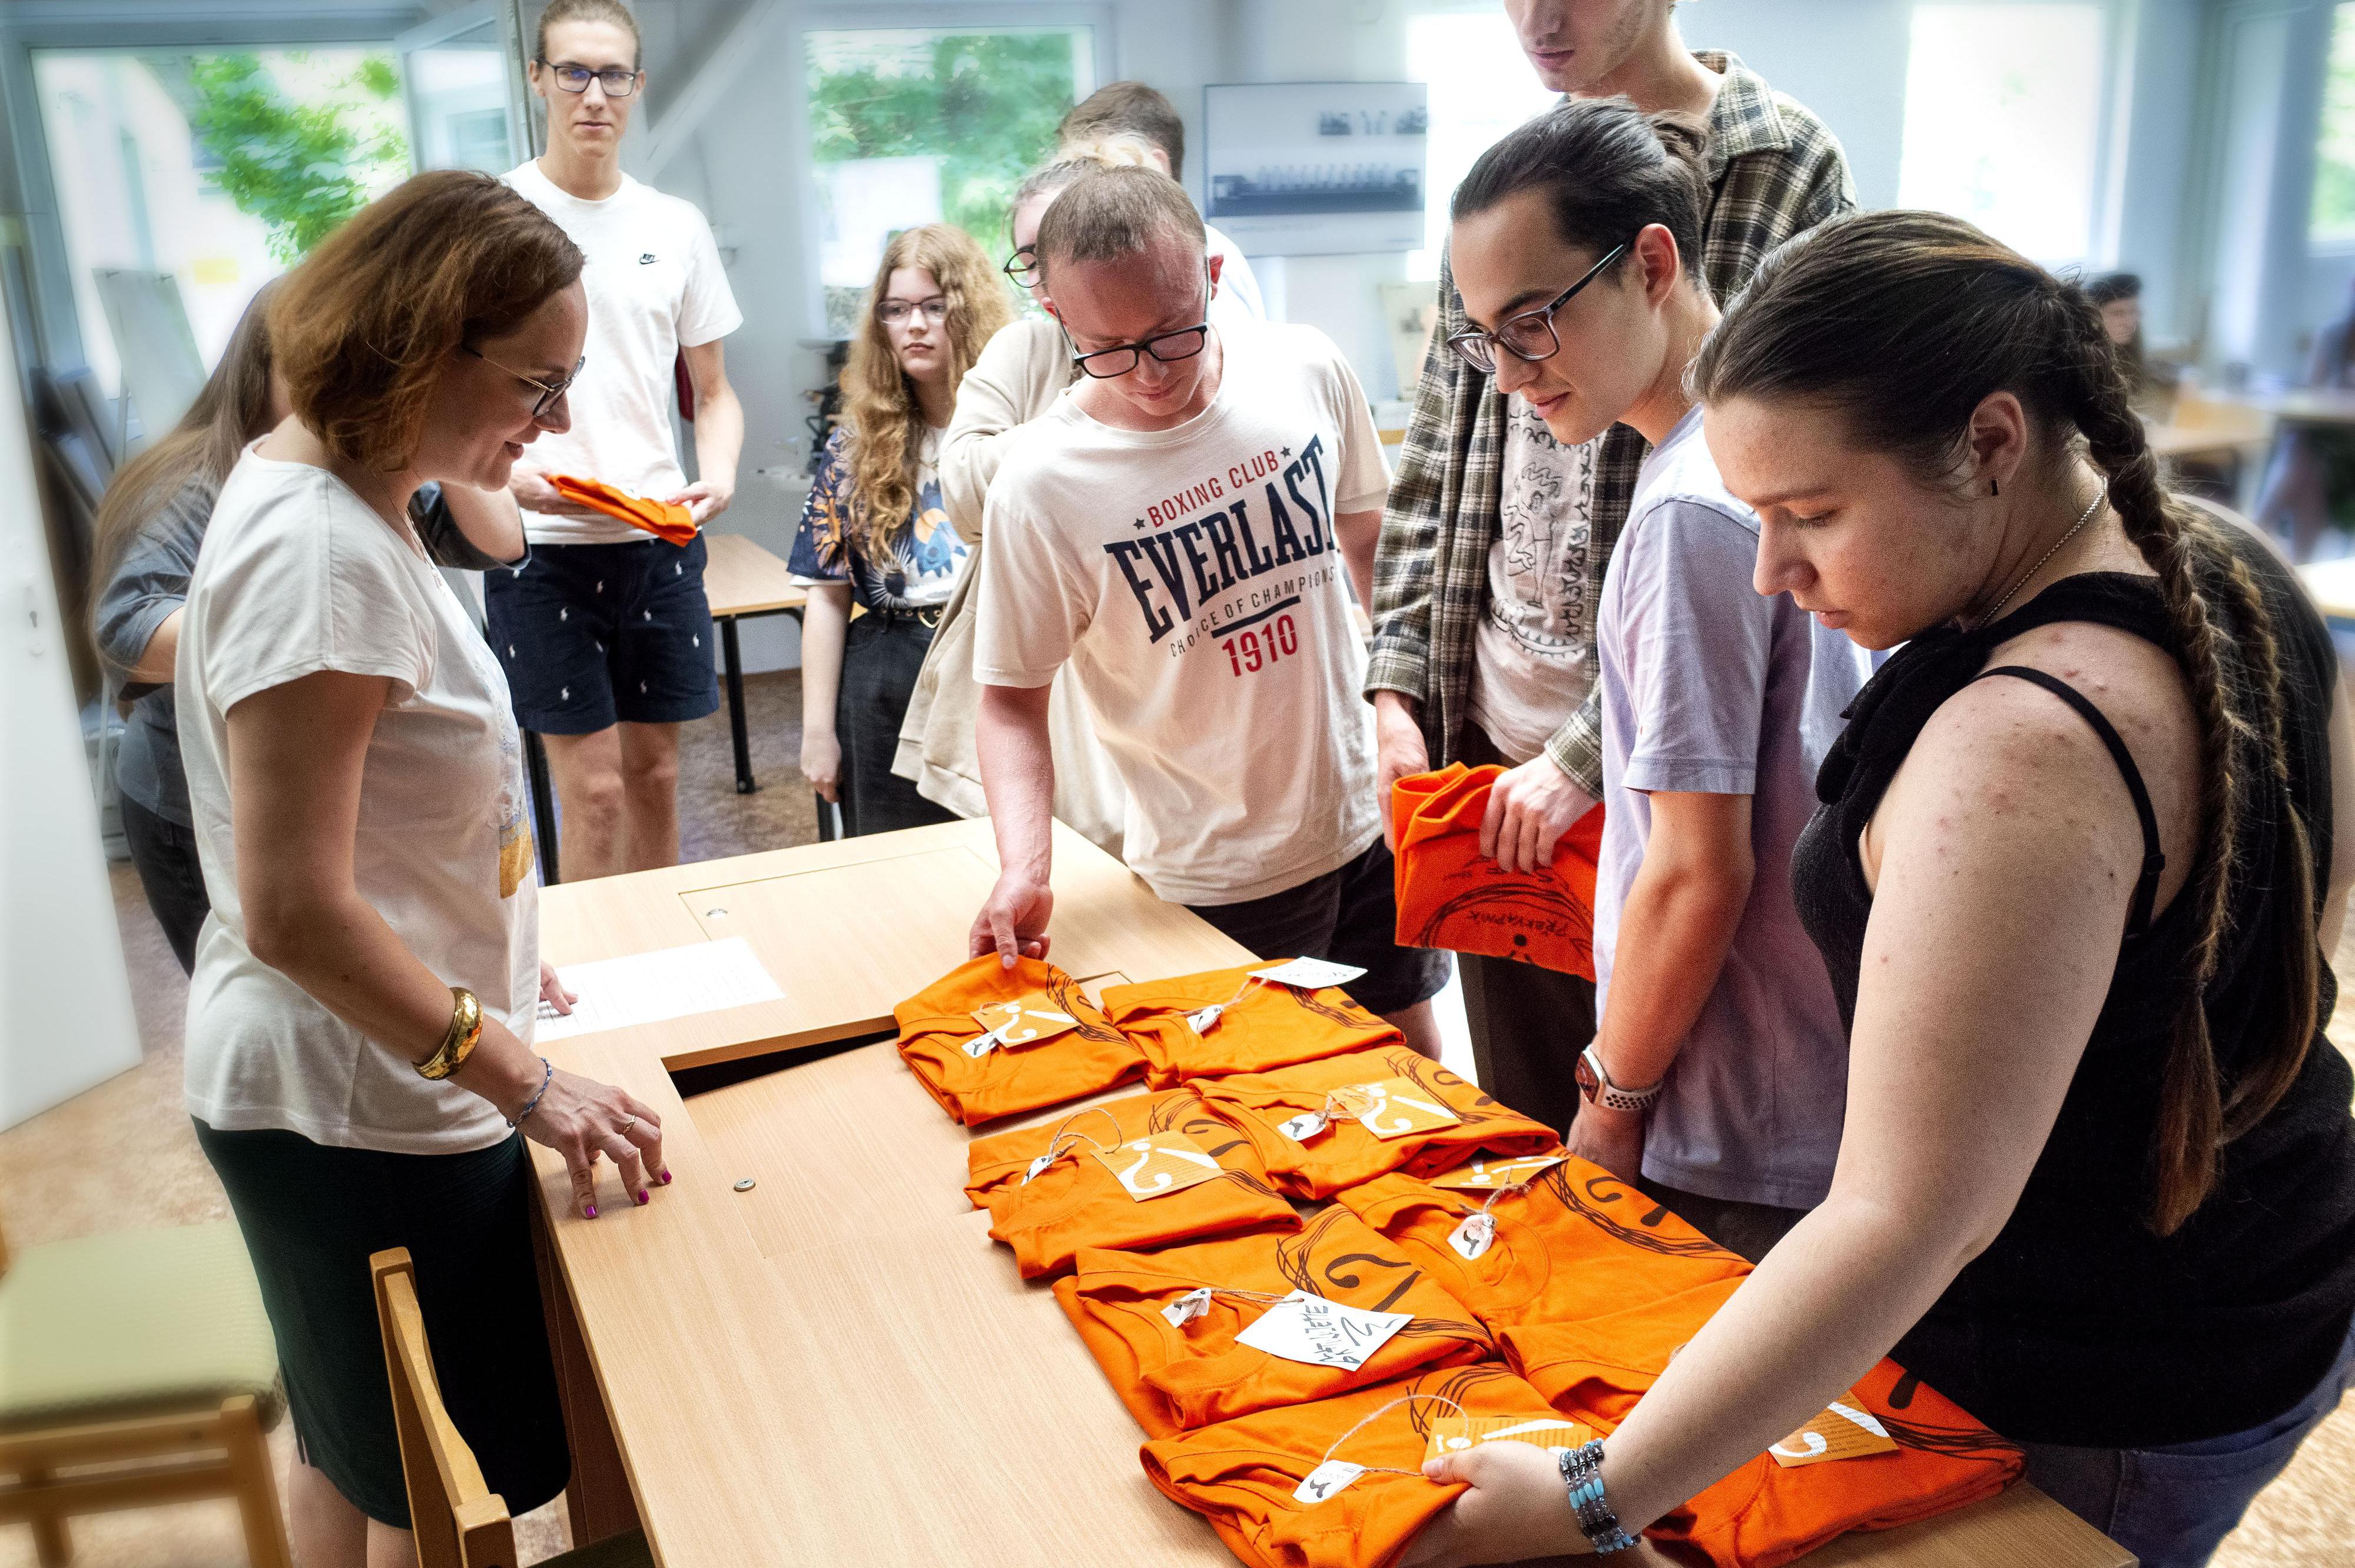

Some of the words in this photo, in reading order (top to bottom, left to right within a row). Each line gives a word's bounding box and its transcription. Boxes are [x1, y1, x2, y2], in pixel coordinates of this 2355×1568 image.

[1147, 477, 1224, 528] BOXING
[1229, 450, 1279, 489] CLUB
[1103, 433, 1340, 644] EVERLAST
[1170, 616, 1220, 657] CHOICE
[1225, 598, 1245, 619] OF
[1251, 566, 1336, 609] CHAMPIONS
[1222, 614, 1298, 677] 1910
